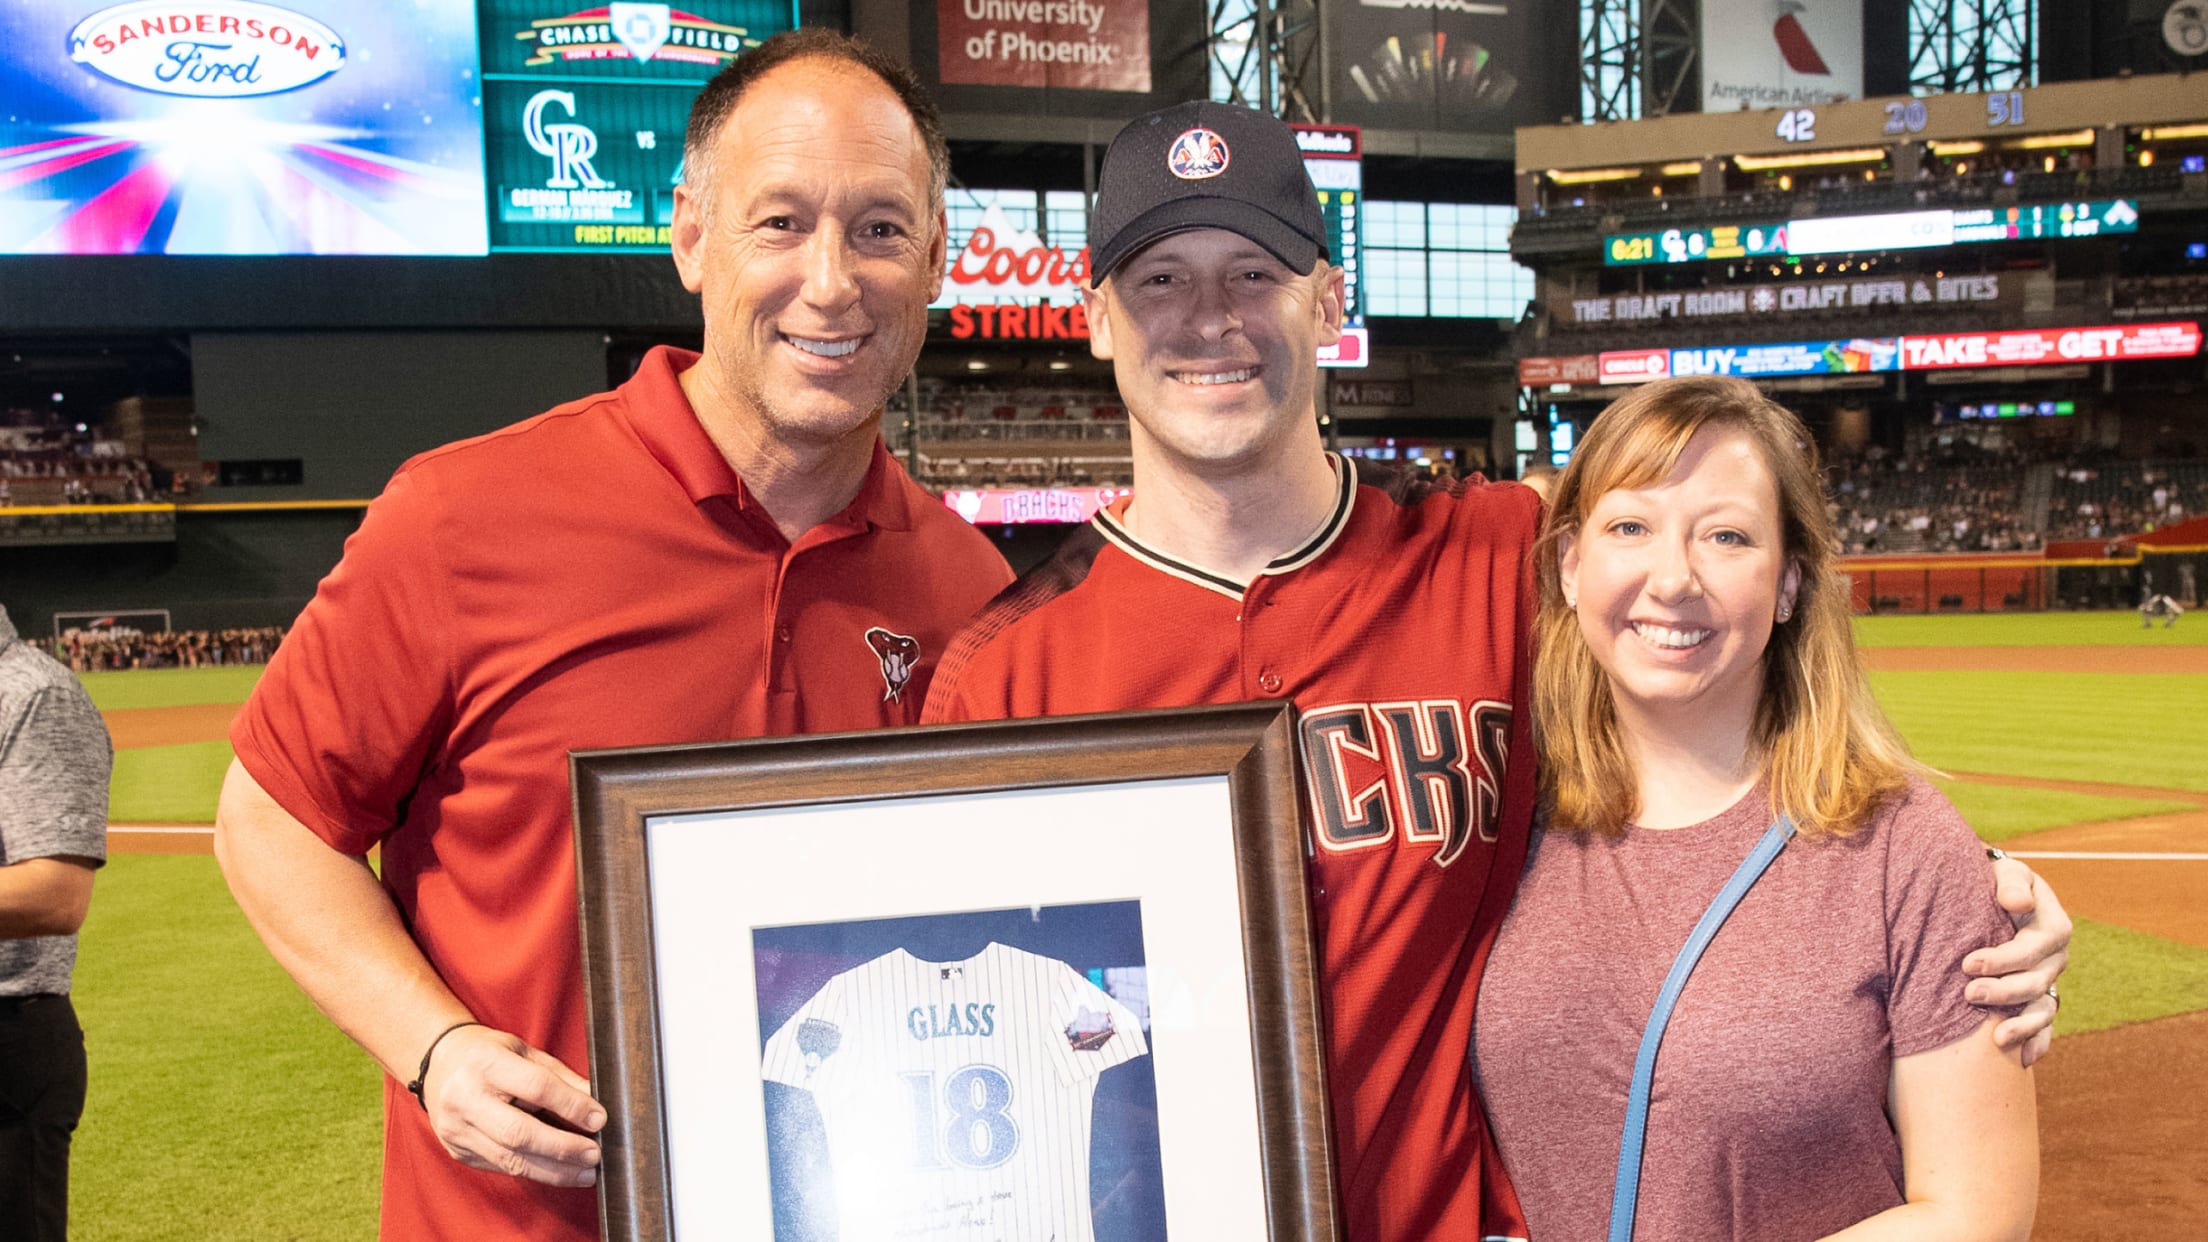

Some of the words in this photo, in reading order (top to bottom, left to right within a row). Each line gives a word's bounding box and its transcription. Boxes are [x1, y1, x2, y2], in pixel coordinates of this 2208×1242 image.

[964, 0, 1104, 33] University
[93, 14, 320, 60] SANDERSON
[541, 24, 611, 46] CHASE
[671, 27, 740, 52] FIELD
[966, 30, 997, 60] of
[1001, 32, 1113, 64] Phoenix
[155, 41, 262, 84] Ford
[1712, 82, 1789, 102] American
[1987, 91, 2024, 126] 51
[1776, 108, 1816, 142] 42
[1884, 100, 1928, 134] 20
[575, 226, 614, 244] FIRST
[615, 226, 656, 244] PITCH
[950, 226, 1091, 286] Coors
[1573, 300, 1611, 322] THE
[1615, 294, 1682, 320] DRAFT
[1685, 290, 1746, 316] ROOM
[1780, 283, 1848, 311] CRAFT
[1850, 280, 1907, 306] BEER
[1911, 280, 1932, 304] &
[1936, 275, 1999, 303] BITES
[950, 303, 1091, 339] STRIKE
[1904, 336, 1989, 365] TAKE
[2058, 330, 2124, 359] GET
[1674, 349, 1736, 377] BUY
[1298, 700, 1513, 868] CKS
[907, 1002, 995, 1041] GLASS
[898, 1063, 1020, 1169] 18
